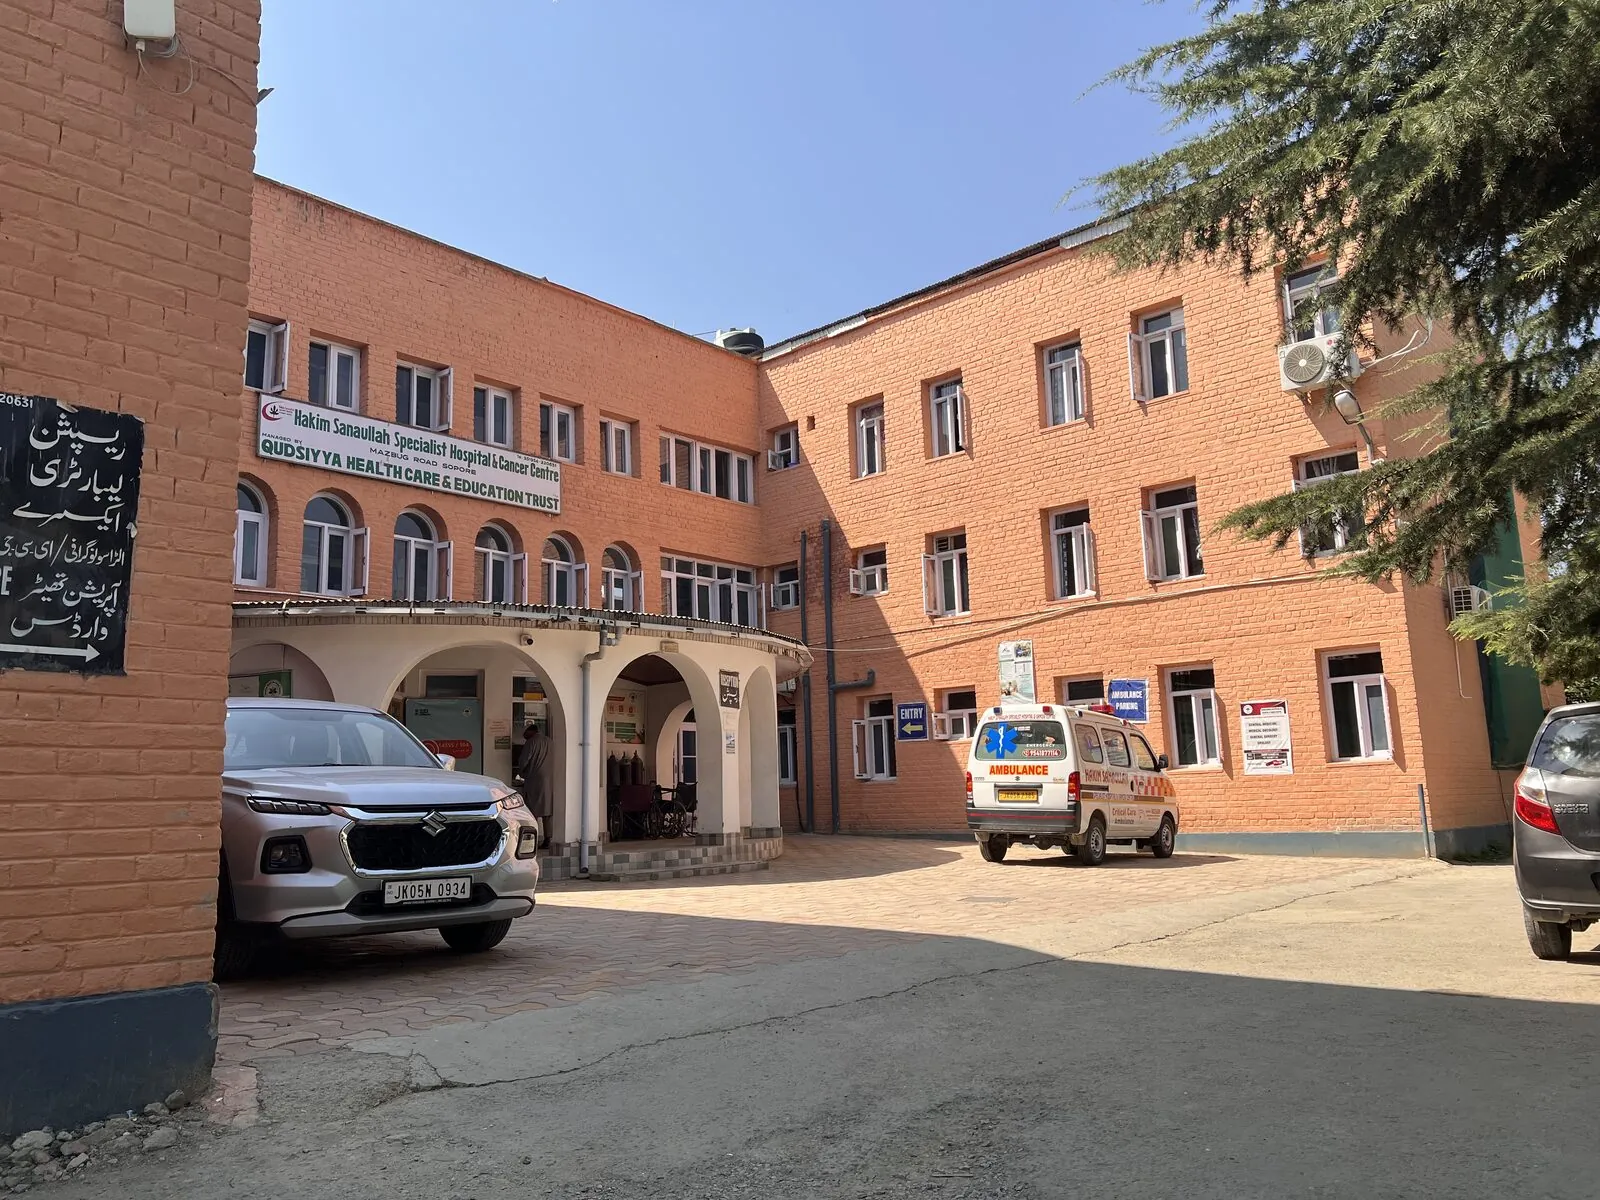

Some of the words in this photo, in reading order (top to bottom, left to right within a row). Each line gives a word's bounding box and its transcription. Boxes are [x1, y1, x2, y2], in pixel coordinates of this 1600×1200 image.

[261, 432, 292, 442] MANAGED
[294, 408, 330, 432] Hakim
[333, 417, 390, 445] Sanaullah
[394, 431, 447, 457] Specialist
[450, 443, 491, 468] Hospital
[492, 453, 498, 469] &
[498, 455, 529, 475] Cancer
[530, 462, 559, 482] Centre
[369, 447, 409, 460] MAZBUG
[413, 456, 438, 467] ROAD
[442, 462, 477, 475] SOPORE
[261, 438, 342, 468] QUDSIYYA
[346, 455, 402, 480] HEALTH
[404, 467, 440, 487] CARE
[442, 475, 452, 489] &
[454, 477, 523, 503] EDUCATION
[525, 491, 559, 511] TRUST
[1111, 690, 1143, 699] AMBULANCE
[1115, 702, 1139, 710] PARKING
[900, 708, 924, 720] ENTRY
[989, 765, 1049, 776] AMBULANCE
[1127, 807, 1137, 816] Care
[394, 884, 432, 899] JK05N
[438, 881, 466, 897] 0934
